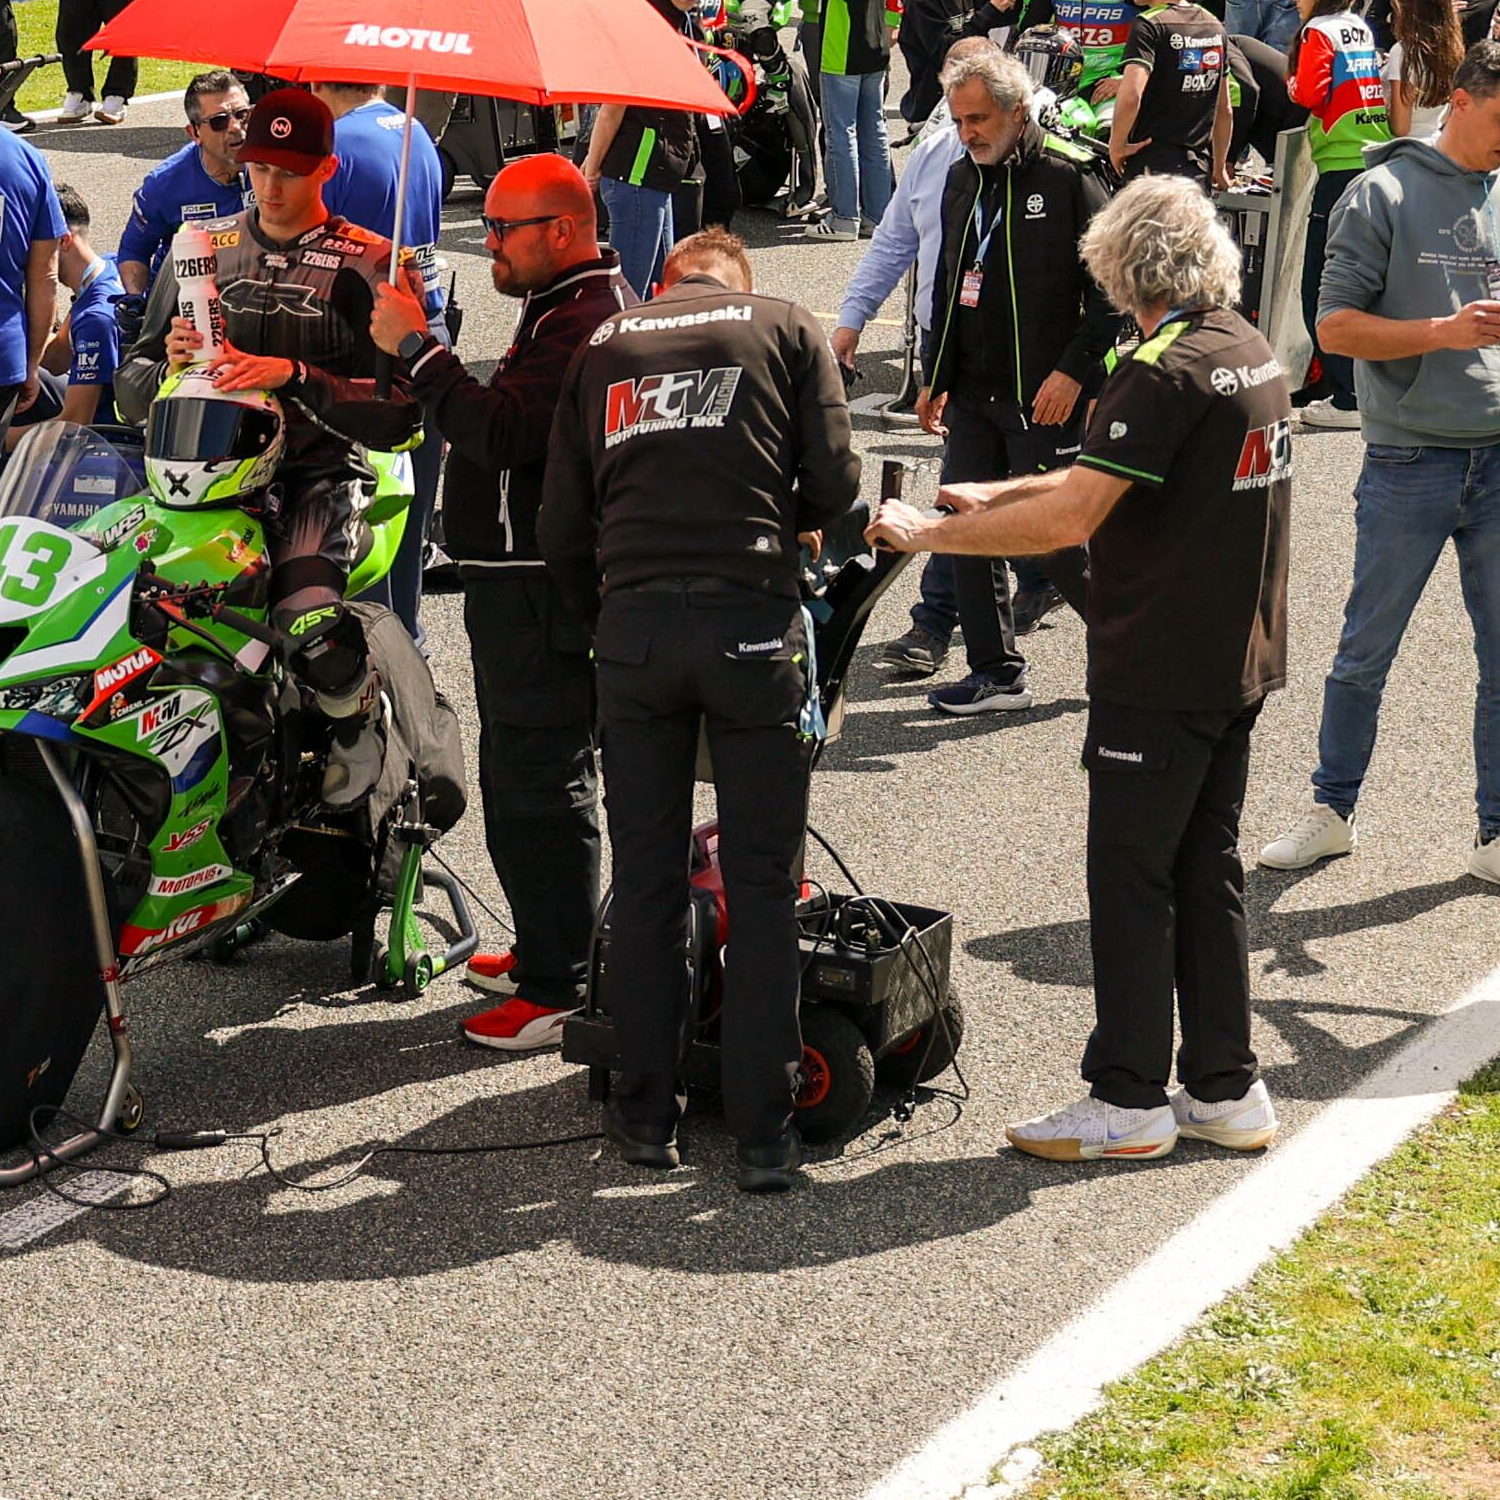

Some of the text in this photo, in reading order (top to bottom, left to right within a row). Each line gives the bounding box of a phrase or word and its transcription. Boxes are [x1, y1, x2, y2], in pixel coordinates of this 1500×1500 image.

[344, 23, 474, 55] MOTUL
[1068, 26, 1114, 45] eza
[1340, 27, 1365, 45] BOX
[175, 256, 219, 279] 226ERS
[301, 250, 342, 270] 226ERS
[208, 297, 224, 347] 226ERS
[619, 305, 753, 334] Kawasaki
[605, 367, 725, 437] MtM
[712, 368, 741, 415] RACING
[690, 414, 725, 429] MOL
[53, 502, 101, 517] YAMAHA
[105, 504, 145, 545] WRS
[739, 638, 784, 653] Kawasaki
[96, 649, 154, 692] MOTUL
[154, 700, 212, 756] ZX
[1098, 746, 1143, 764] Kawasaki
[159, 815, 214, 853] YSS
[157, 866, 218, 894] MOTOPLUS
[132, 910, 204, 955] MOTUL
